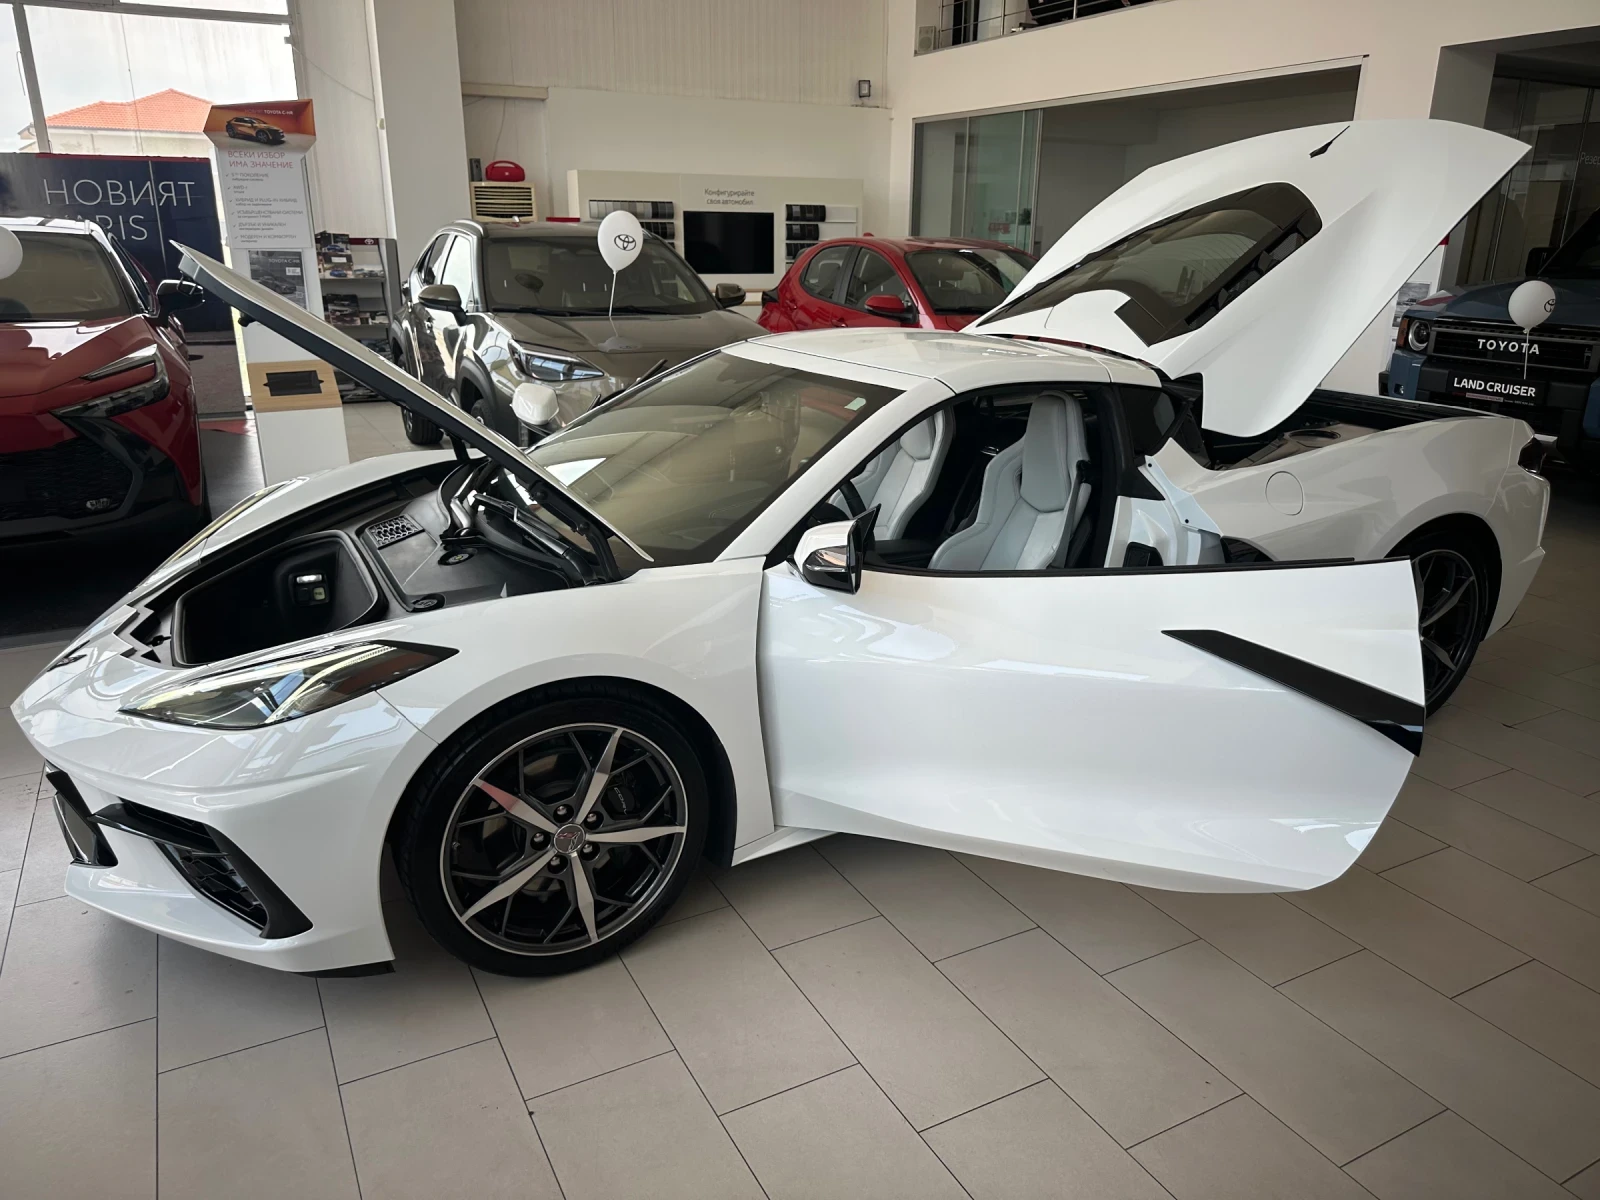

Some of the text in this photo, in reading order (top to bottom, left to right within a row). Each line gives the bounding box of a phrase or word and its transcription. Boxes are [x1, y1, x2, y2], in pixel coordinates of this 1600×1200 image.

[257, 151, 285, 159] ИЗБОР
[43, 178, 195, 207] НОВИЯТ
[704, 188, 755, 197] Конфигурирайте
[1477, 338, 1540, 355] TOYOTA
[1453, 377, 1536, 397] LAND CRUISER
